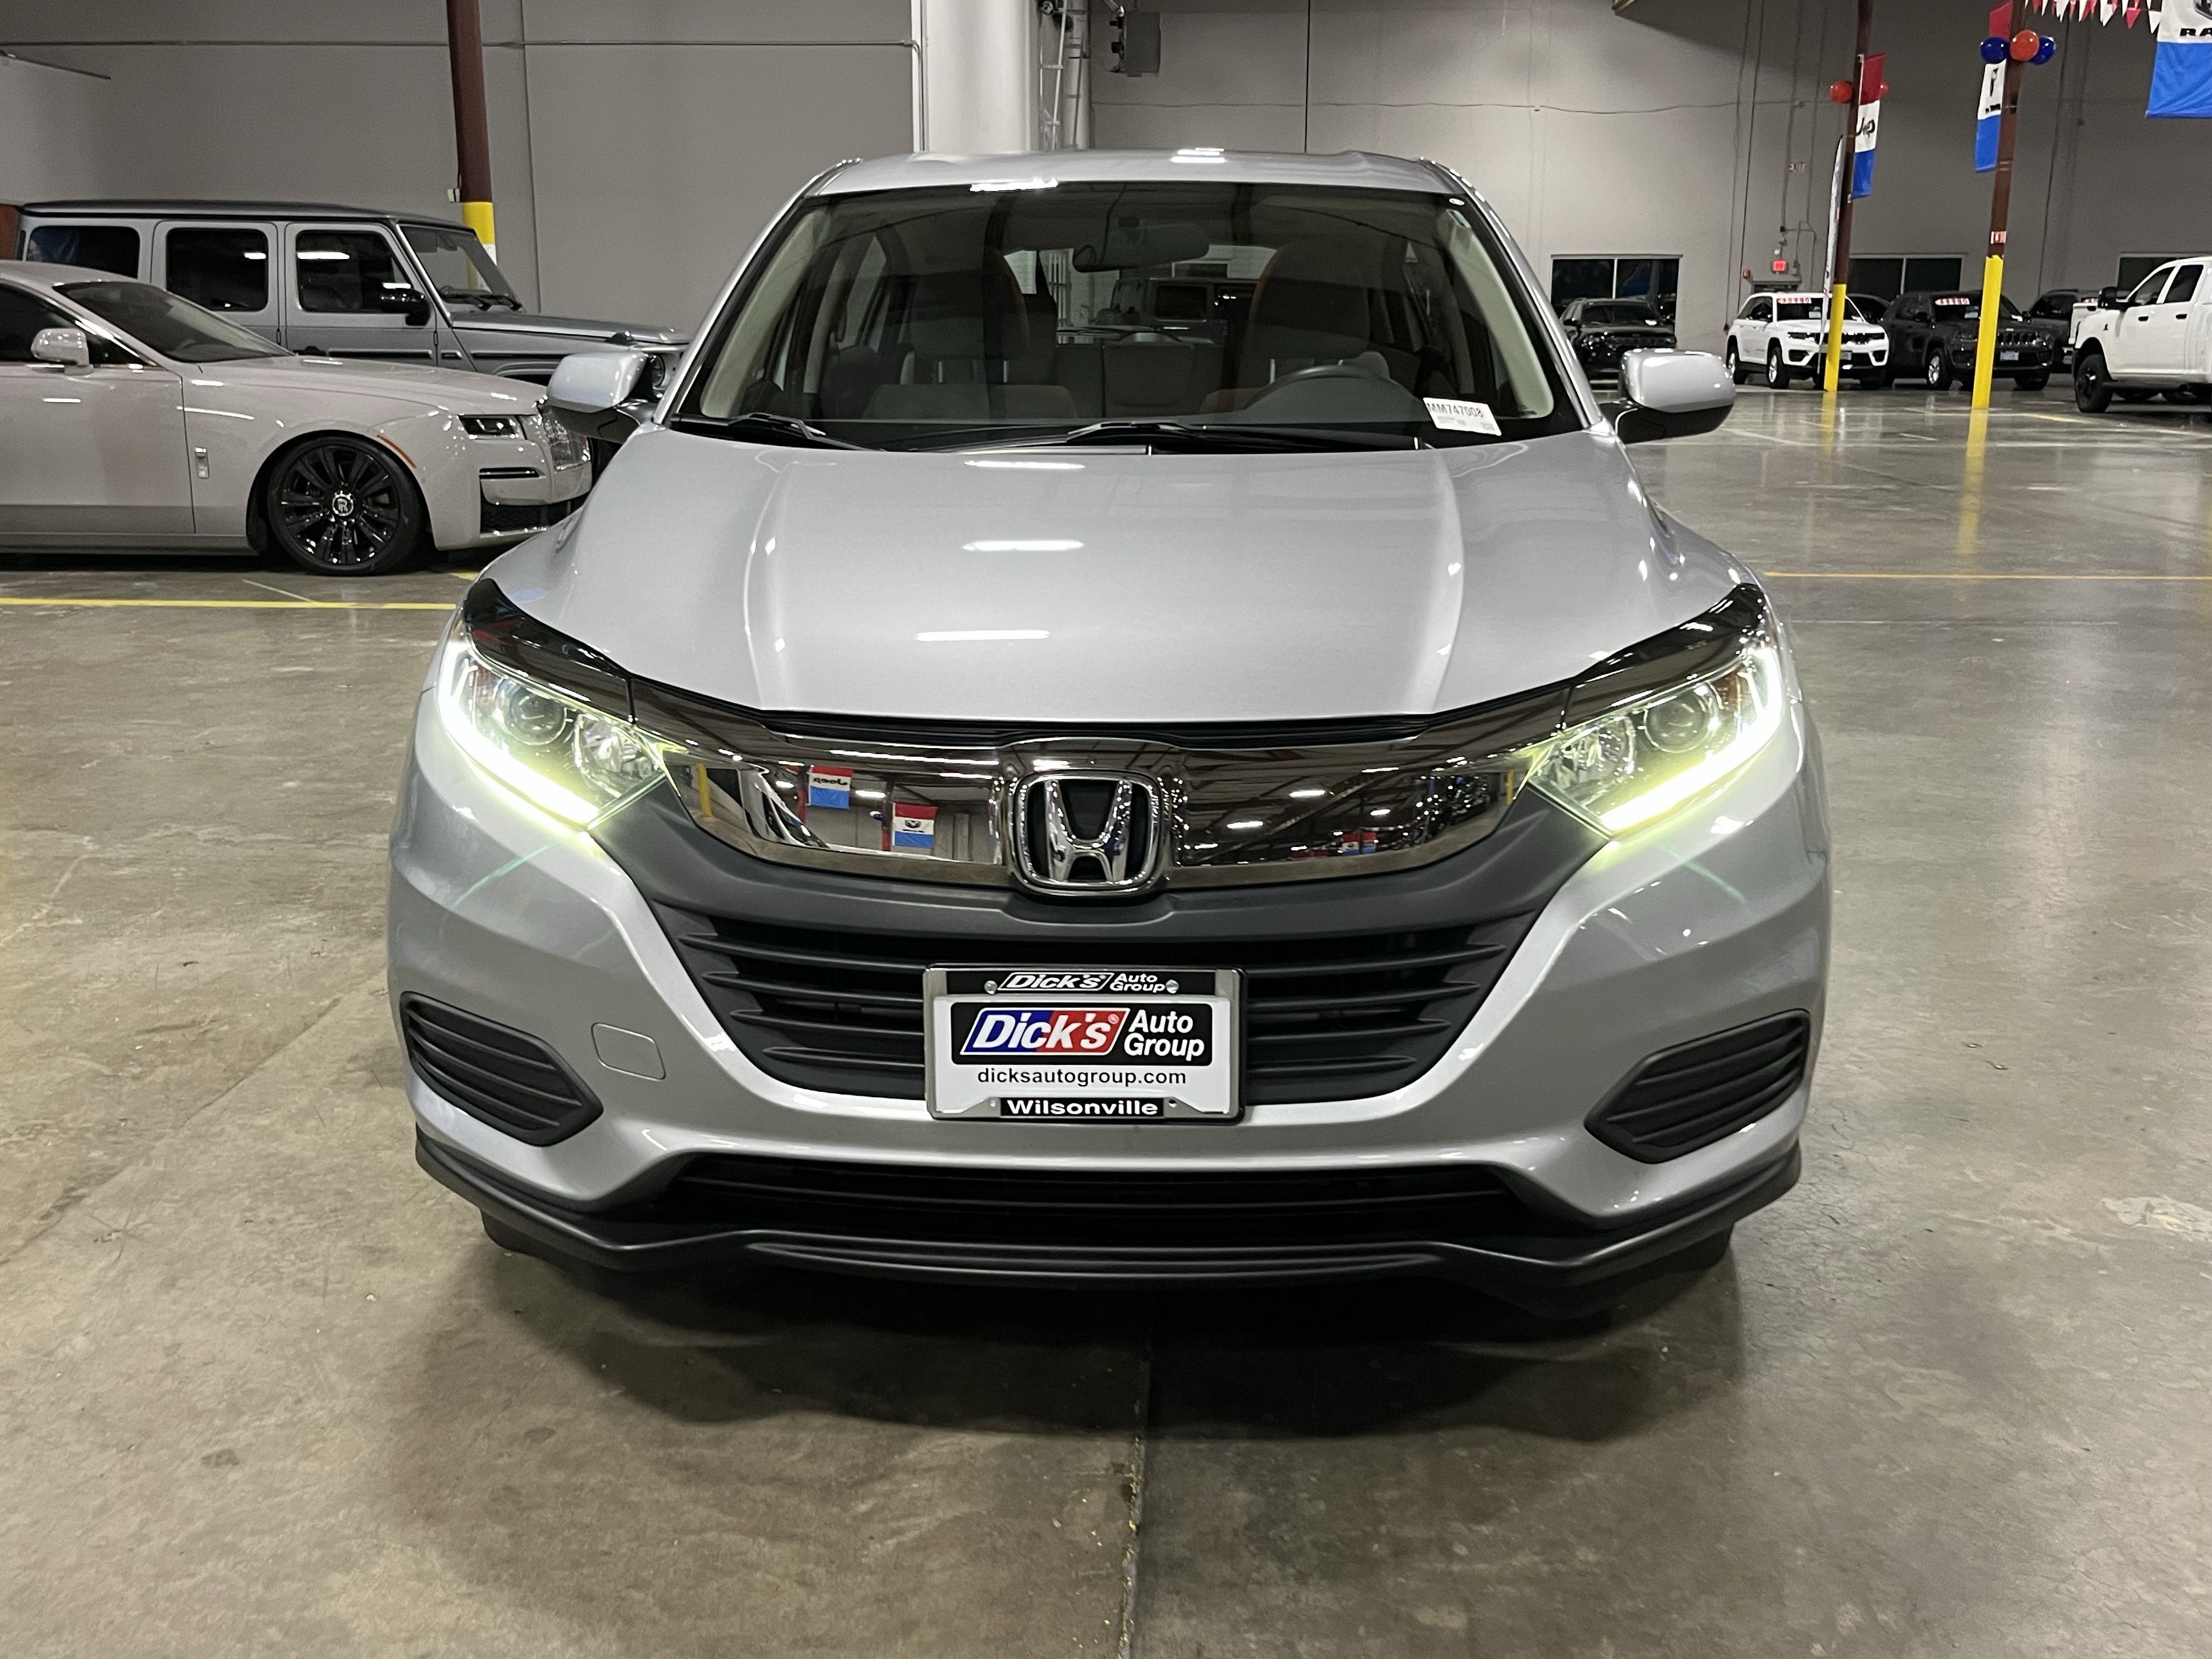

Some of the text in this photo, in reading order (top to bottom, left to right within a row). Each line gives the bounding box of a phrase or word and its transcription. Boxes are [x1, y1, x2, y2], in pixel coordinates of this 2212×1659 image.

[1114, 973, 1158, 982] Auto
[1110, 982, 1165, 993] Group
[1128, 1009, 1193, 1034] Auto
[1124, 1032, 1205, 1060] Group
[978, 1068, 1186, 1087] dicksautogroup.com
[1006, 1099, 1158, 1115] Wilsonville
